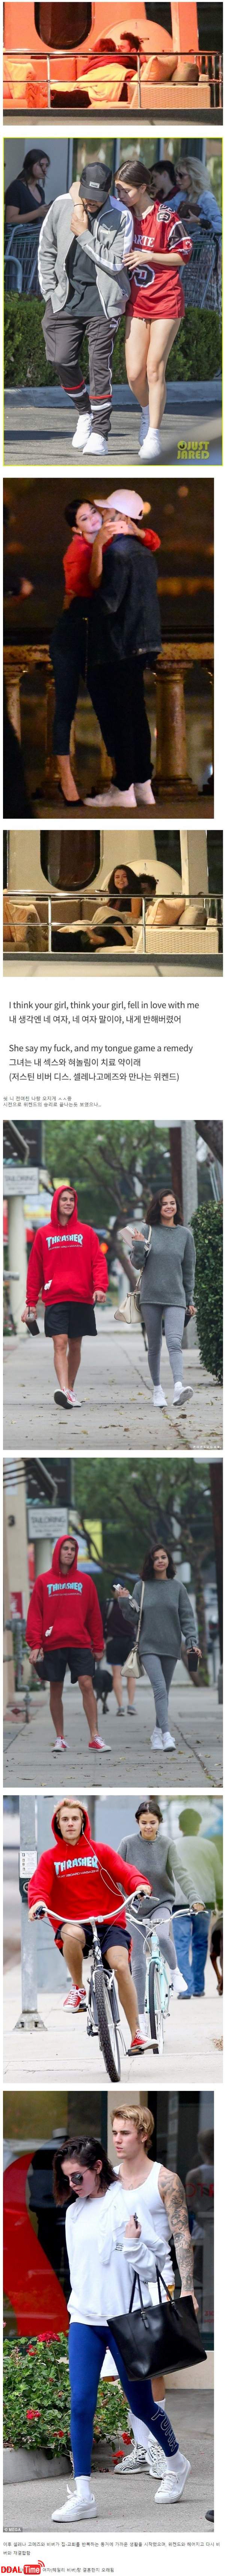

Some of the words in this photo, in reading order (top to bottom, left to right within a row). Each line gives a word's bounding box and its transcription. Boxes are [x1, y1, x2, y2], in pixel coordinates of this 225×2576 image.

[46, 1234, 83, 1248] THRASHER
[47, 1583, 82, 1595] THRASHER
[54, 1855, 99, 1876] THRASHER
[151, 2406, 177, 2452] PUMA
